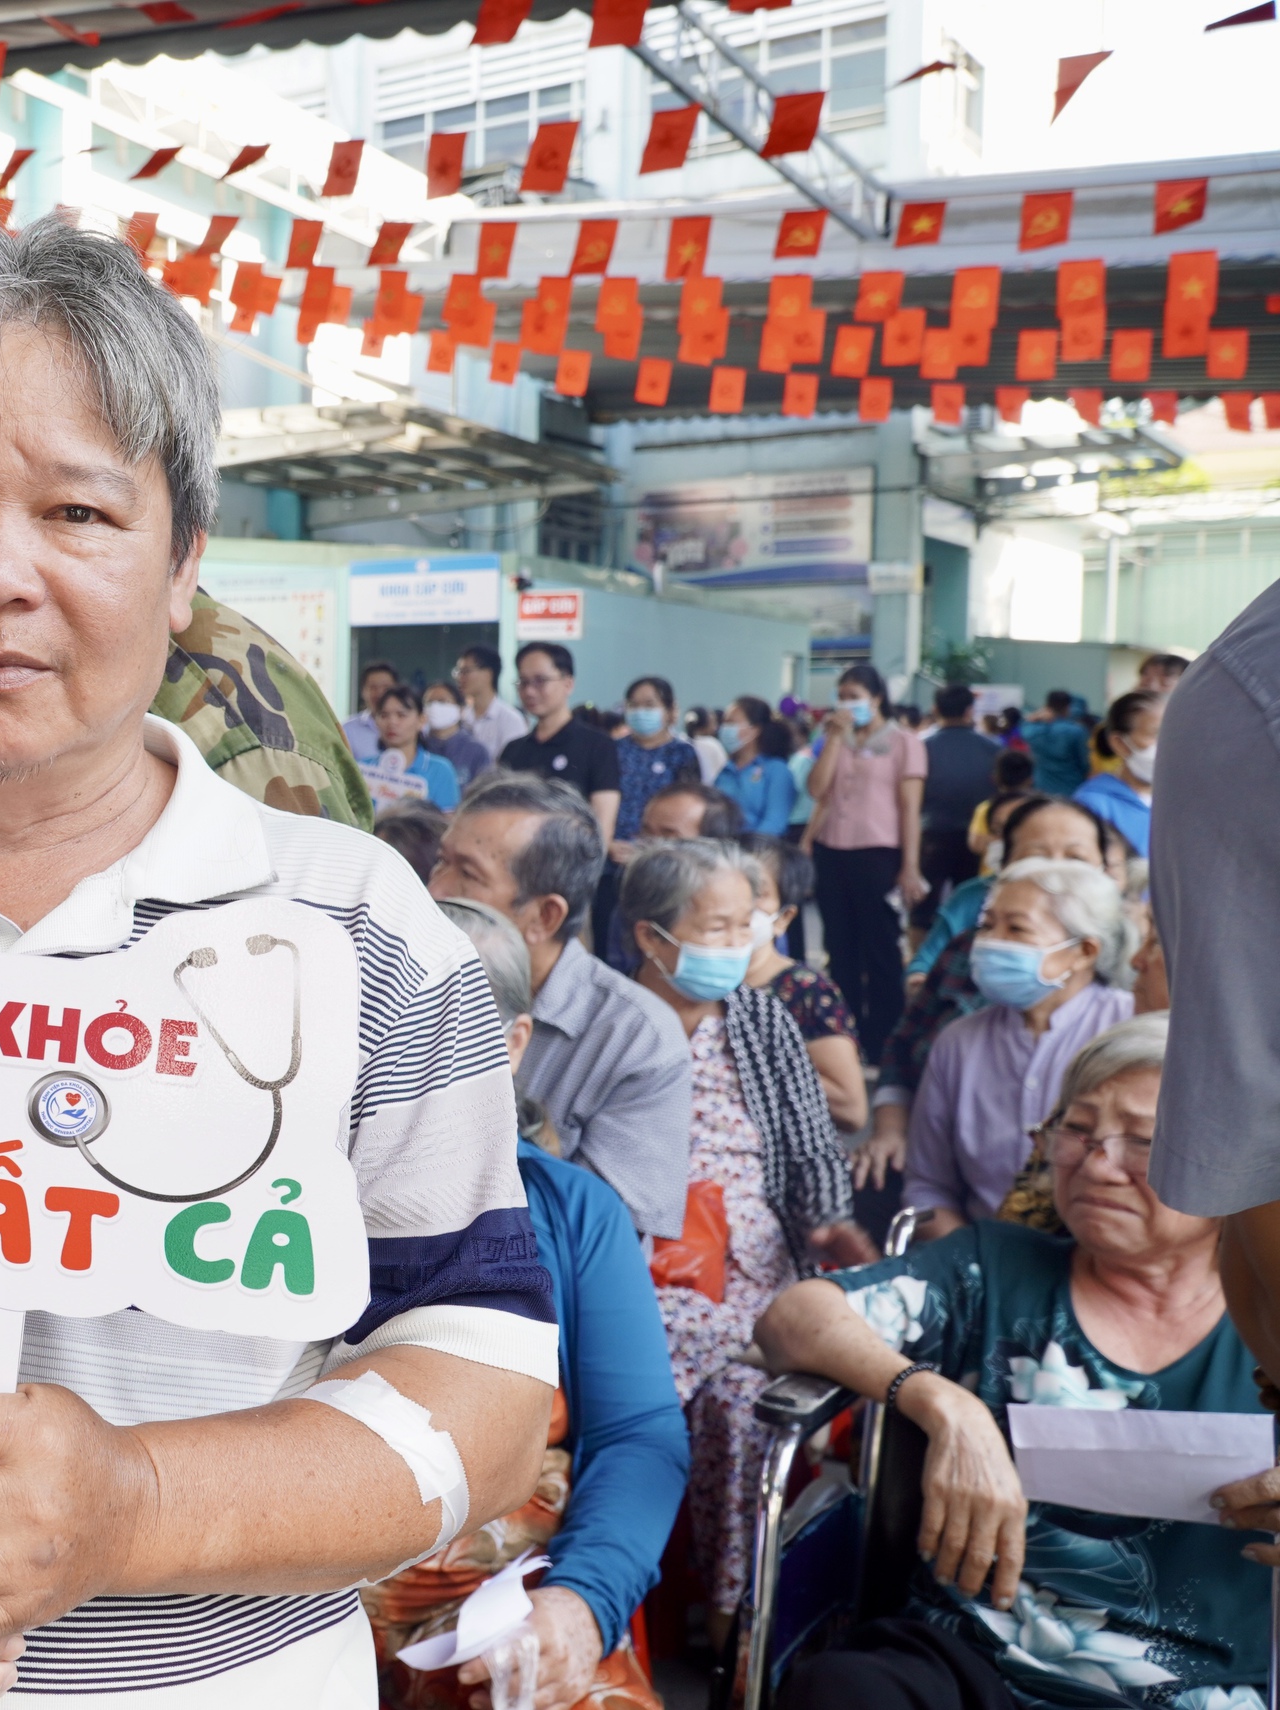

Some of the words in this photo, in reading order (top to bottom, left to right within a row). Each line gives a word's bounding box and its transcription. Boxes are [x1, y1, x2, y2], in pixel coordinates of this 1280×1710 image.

[41, 1089, 51, 1103] BỆNH
[50, 1083, 60, 1092] VIỆN
[69, 1082, 83, 1090] KHOA
[53, 1126, 76, 1135] GENERAL
[75, 1116, 94, 1134] HOSPITAL
[164, 1177, 316, 1296] CẢ
